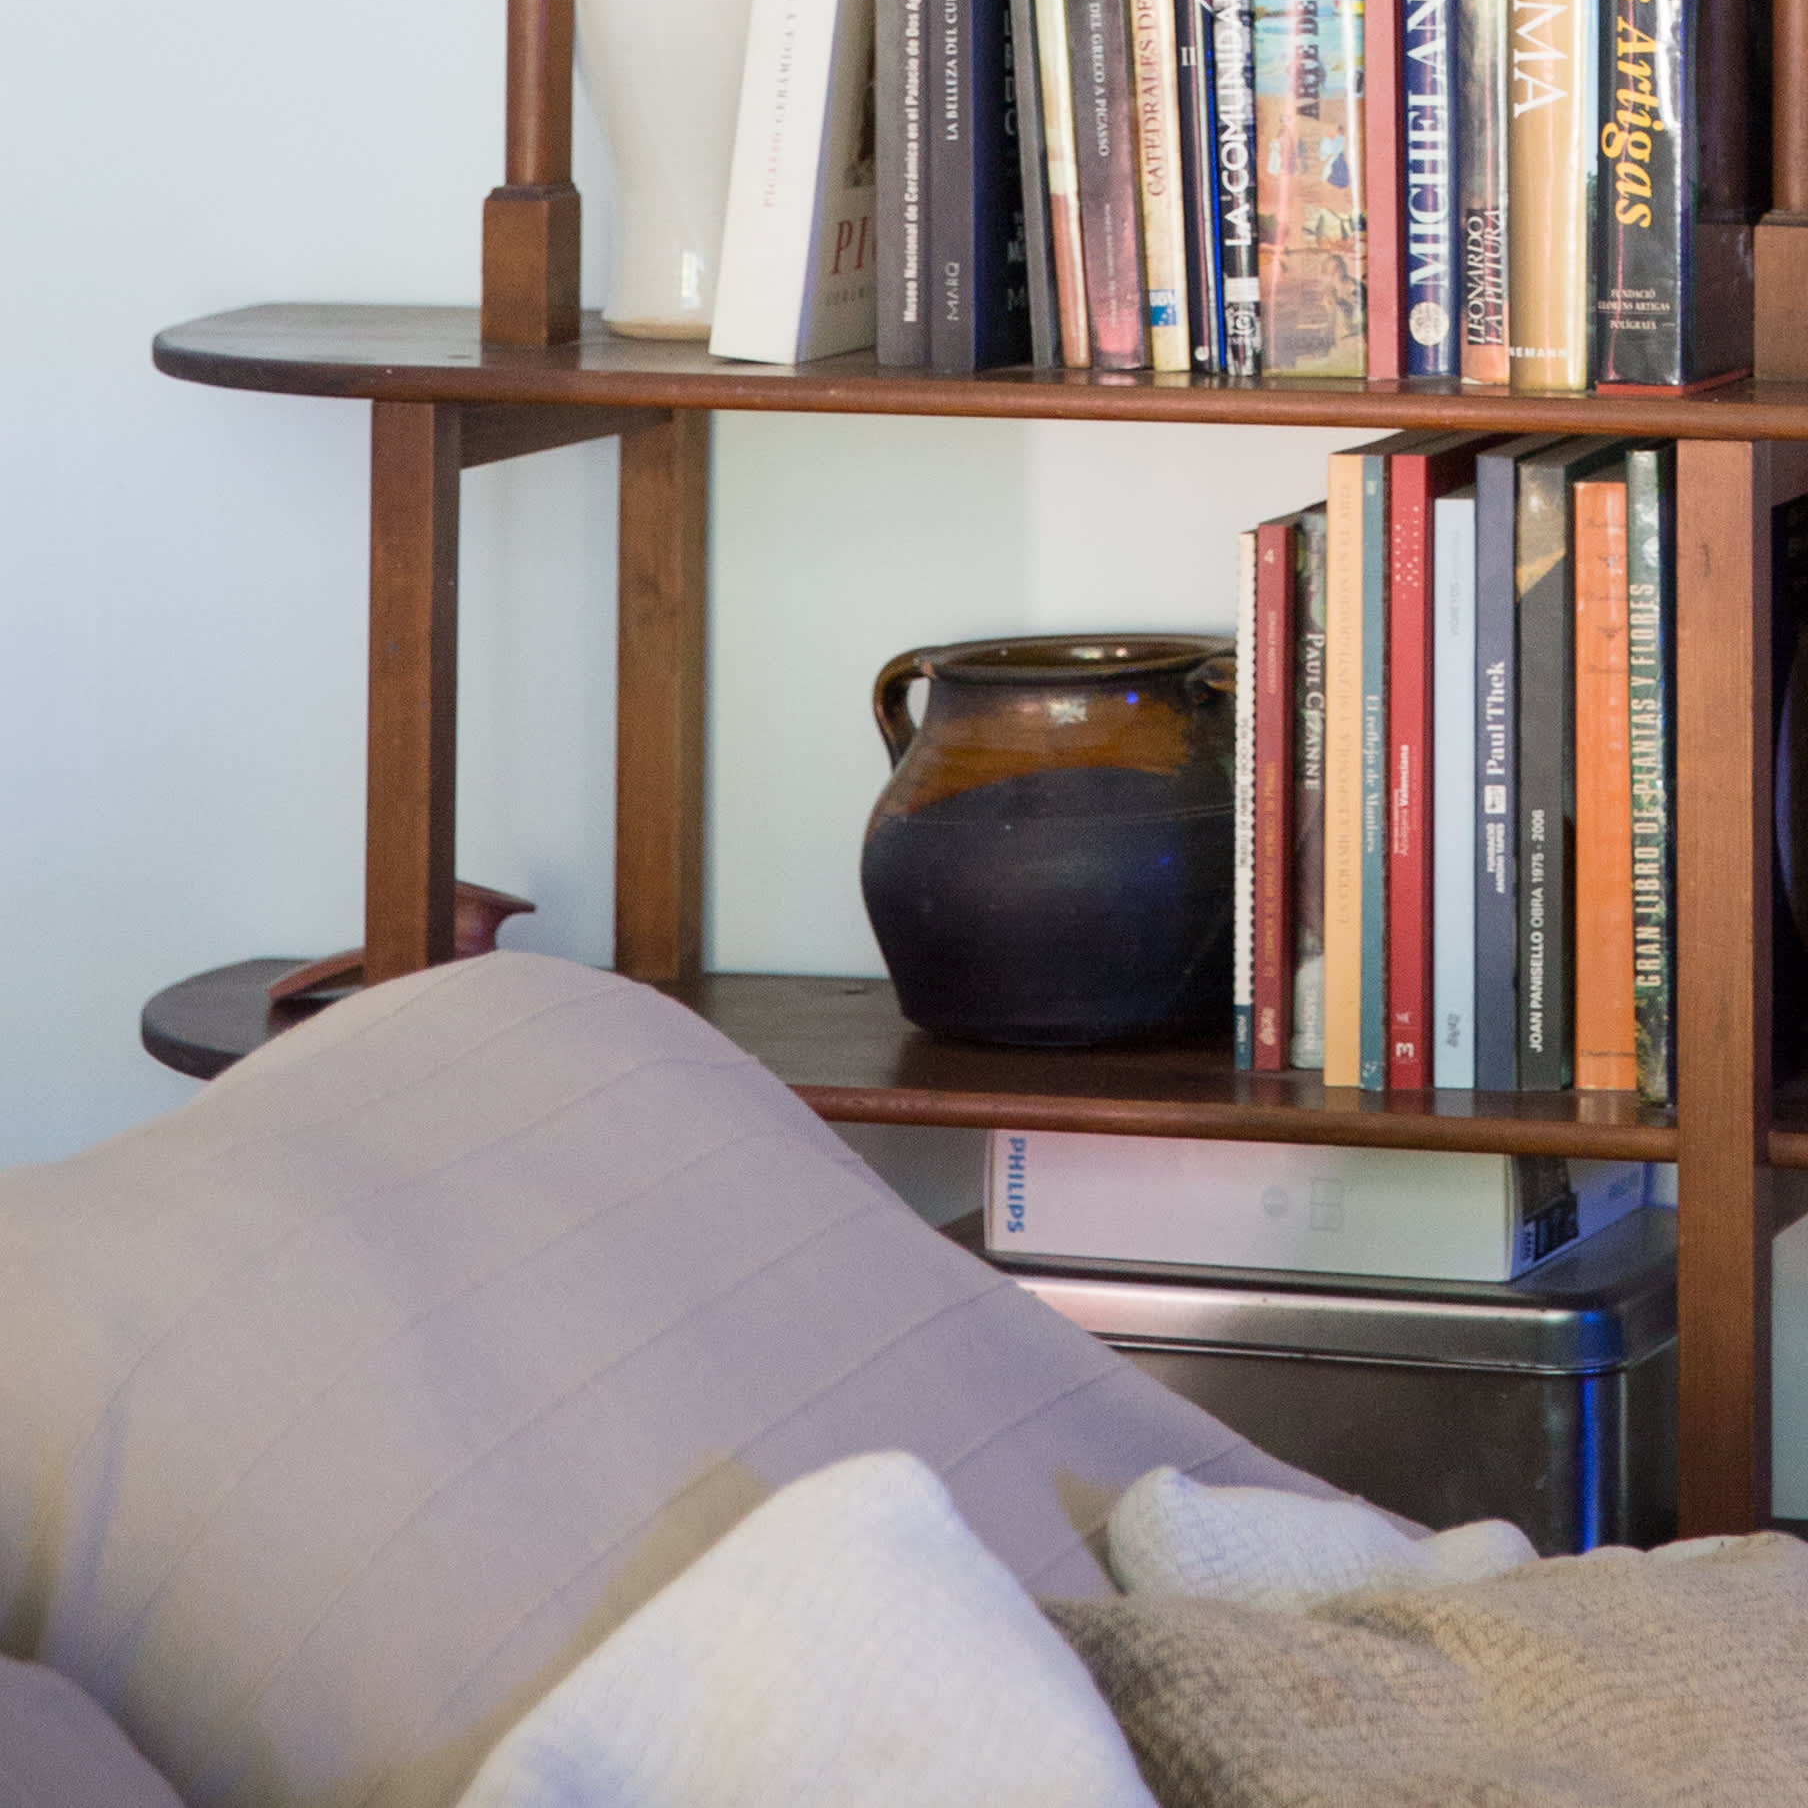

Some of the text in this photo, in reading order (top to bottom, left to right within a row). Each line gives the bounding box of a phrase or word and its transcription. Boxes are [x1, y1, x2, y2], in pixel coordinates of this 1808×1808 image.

[903, 14, 919, 37] Dos
[944, 26, 960, 56] DEL
[1136, 2, 1155, 31] DE
[1297, 0, 1319, 37] DE
[903, 40, 919, 56] de
[903, 58, 919, 104] Palacio
[944, 59, 960, 119] BELLEZA
[1088, 1, 1111, 157] DEL GRECO A PICASSO
[1296, 43, 1320, 121] ARTE
[903, 107, 919, 121] el
[905, 124, 919, 140] en
[944, 124, 960, 141] LA
[1138, 40, 1166, 196] CATEDRALES
[1600, 15, 1664, 228] Artigas
[902, 142, 919, 203] Cerámica
[903, 205, 919, 222] de
[1225, 204, 1253, 247] LA
[903, 224, 919, 279] Nacional
[1484, 208, 1503, 344] LA PITTURA
[903, 282, 920, 322] Museo
[946, 261, 961, 322] MARQ
[1466, 215, 1485, 344] LEONARDO
[1304, 632, 1326, 791] PAUL CÉZANNE
[1485, 661, 1505, 776] Paul Thek
[1362, 694, 1381, 853] El reflejo de Manises
[1628, 583, 1661, 987] GRAN LIBRO DE PLANTAS Y FLORES
[1530, 808, 1545, 841] 2006
[1530, 852, 1545, 883] 1975
[1529, 887, 1544, 928] OBRA
[1529, 931, 1544, 1009] PANISELLO
[1529, 1012, 1544, 1052] JOAN
[1007, 1137, 1027, 1233] PHILIPS
